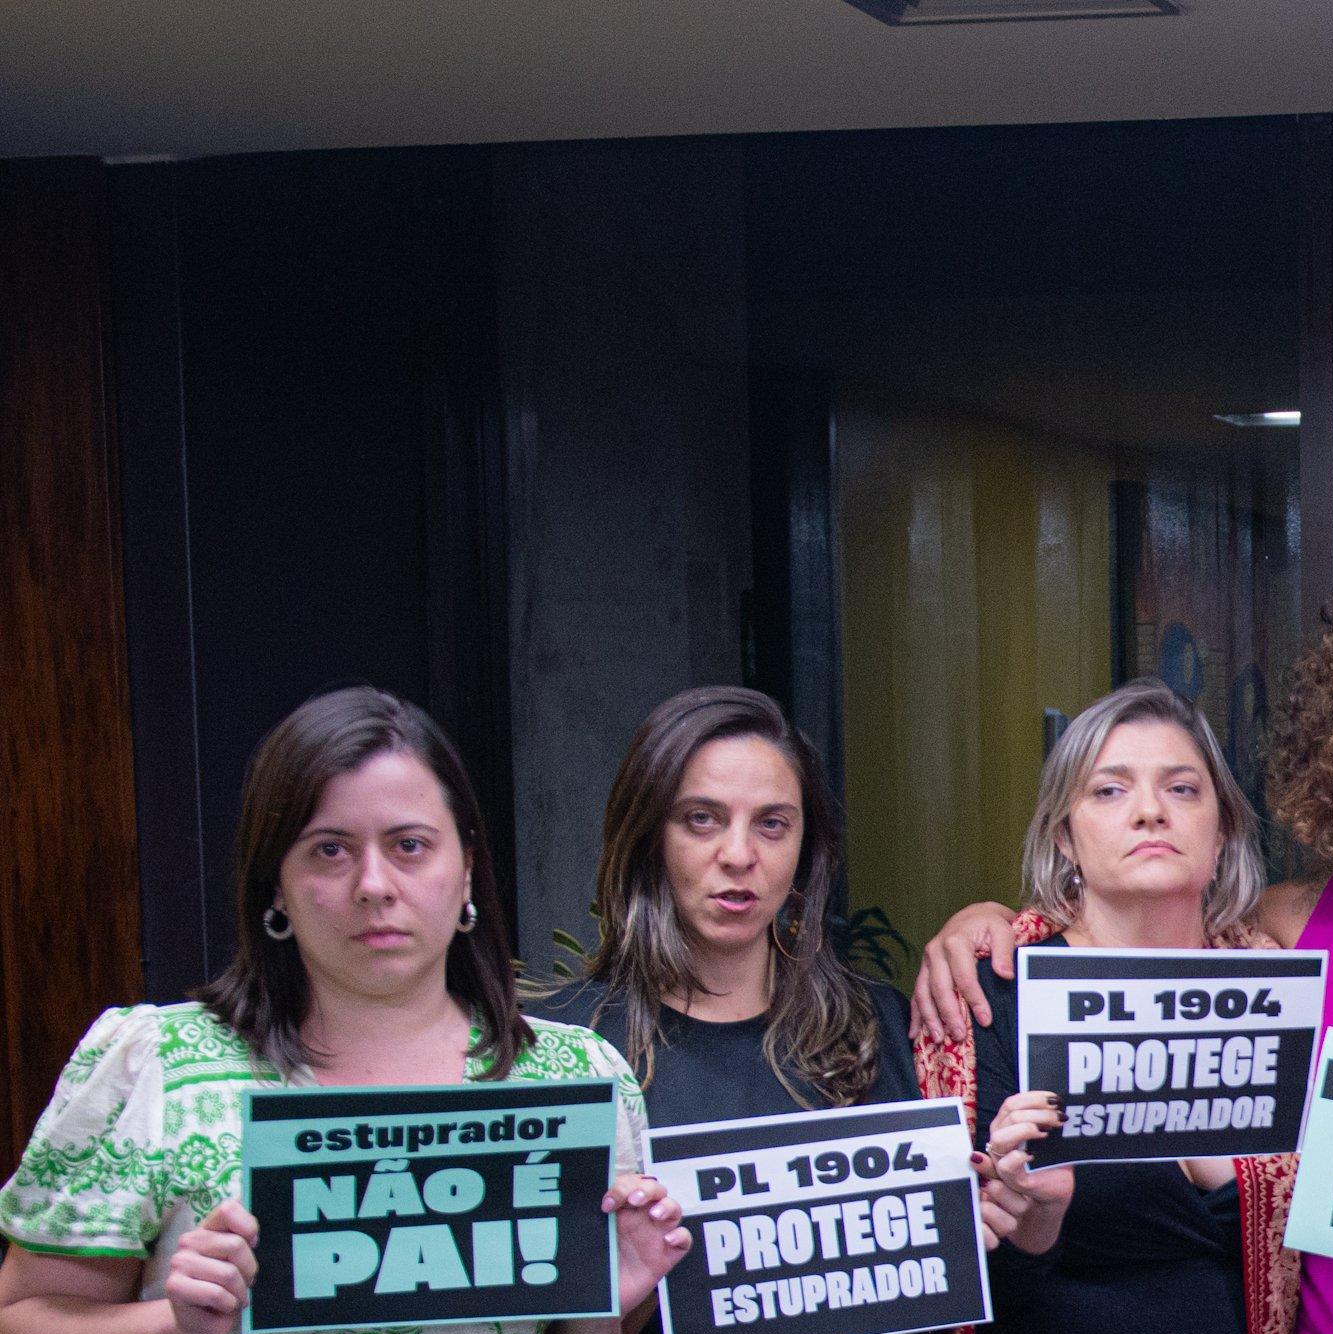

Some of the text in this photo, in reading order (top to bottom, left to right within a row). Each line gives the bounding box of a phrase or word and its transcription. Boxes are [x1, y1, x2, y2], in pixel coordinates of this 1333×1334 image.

[1068, 989, 1282, 1021] PL 1904
[1067, 1035, 1280, 1095] PROTEGE
[295, 1113, 566, 1153] estuprador
[1062, 1096, 1275, 1137] ESTUPRADOR
[293, 1149, 561, 1223] NÃO É
[697, 1142, 928, 1201] PL 1904
[293, 1217, 559, 1300] PAI!
[703, 1191, 939, 1275] PROTEGE
[711, 1259, 947, 1327] ESTUPRADOR
